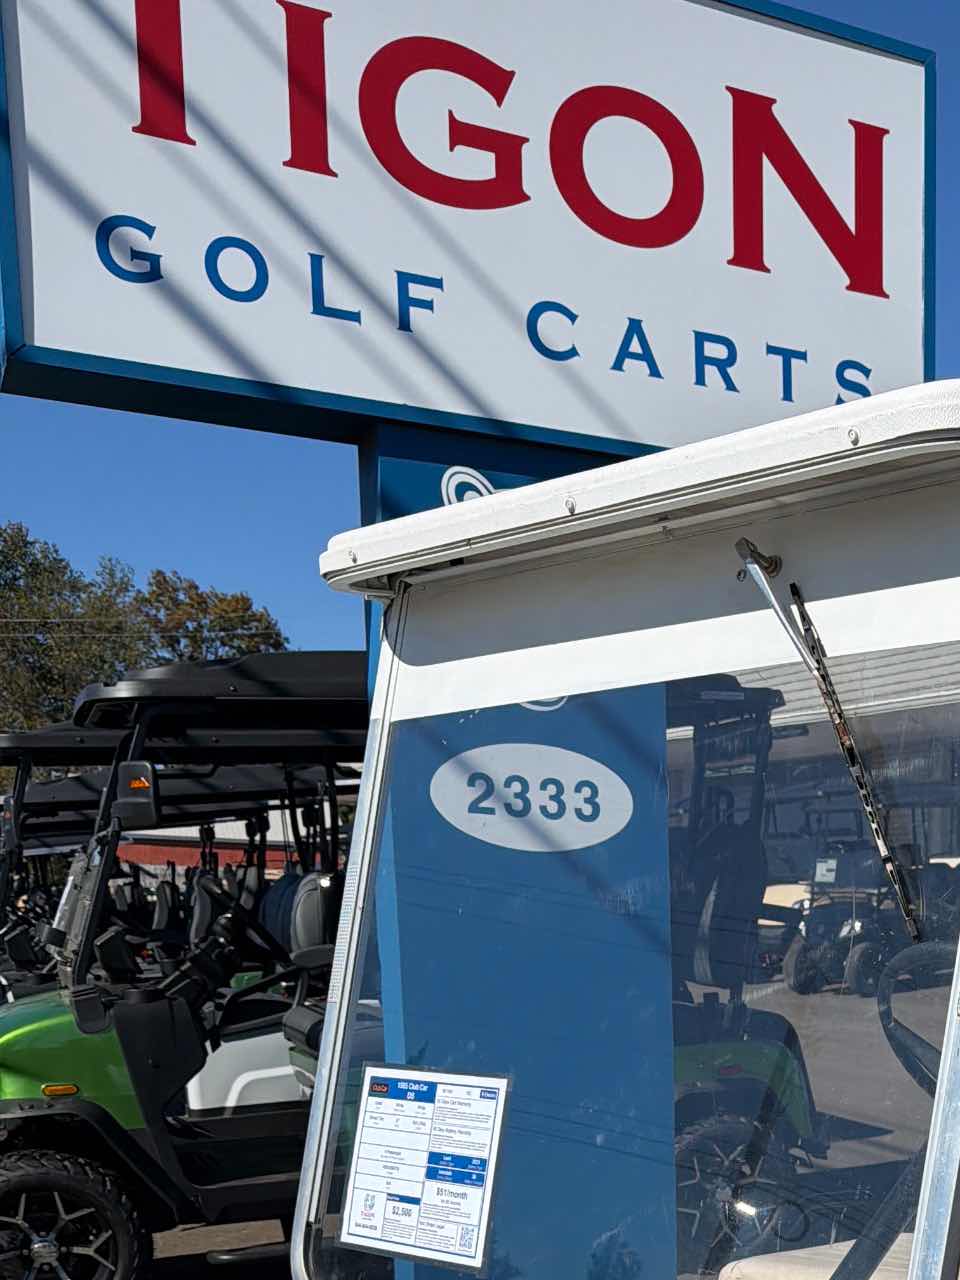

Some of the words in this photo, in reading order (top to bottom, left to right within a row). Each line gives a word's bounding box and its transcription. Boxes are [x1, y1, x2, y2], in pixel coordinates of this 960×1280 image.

[95, 214, 445, 333] GOLF
[526, 300, 873, 405] CARTS
[466, 771, 601, 823] 2333
